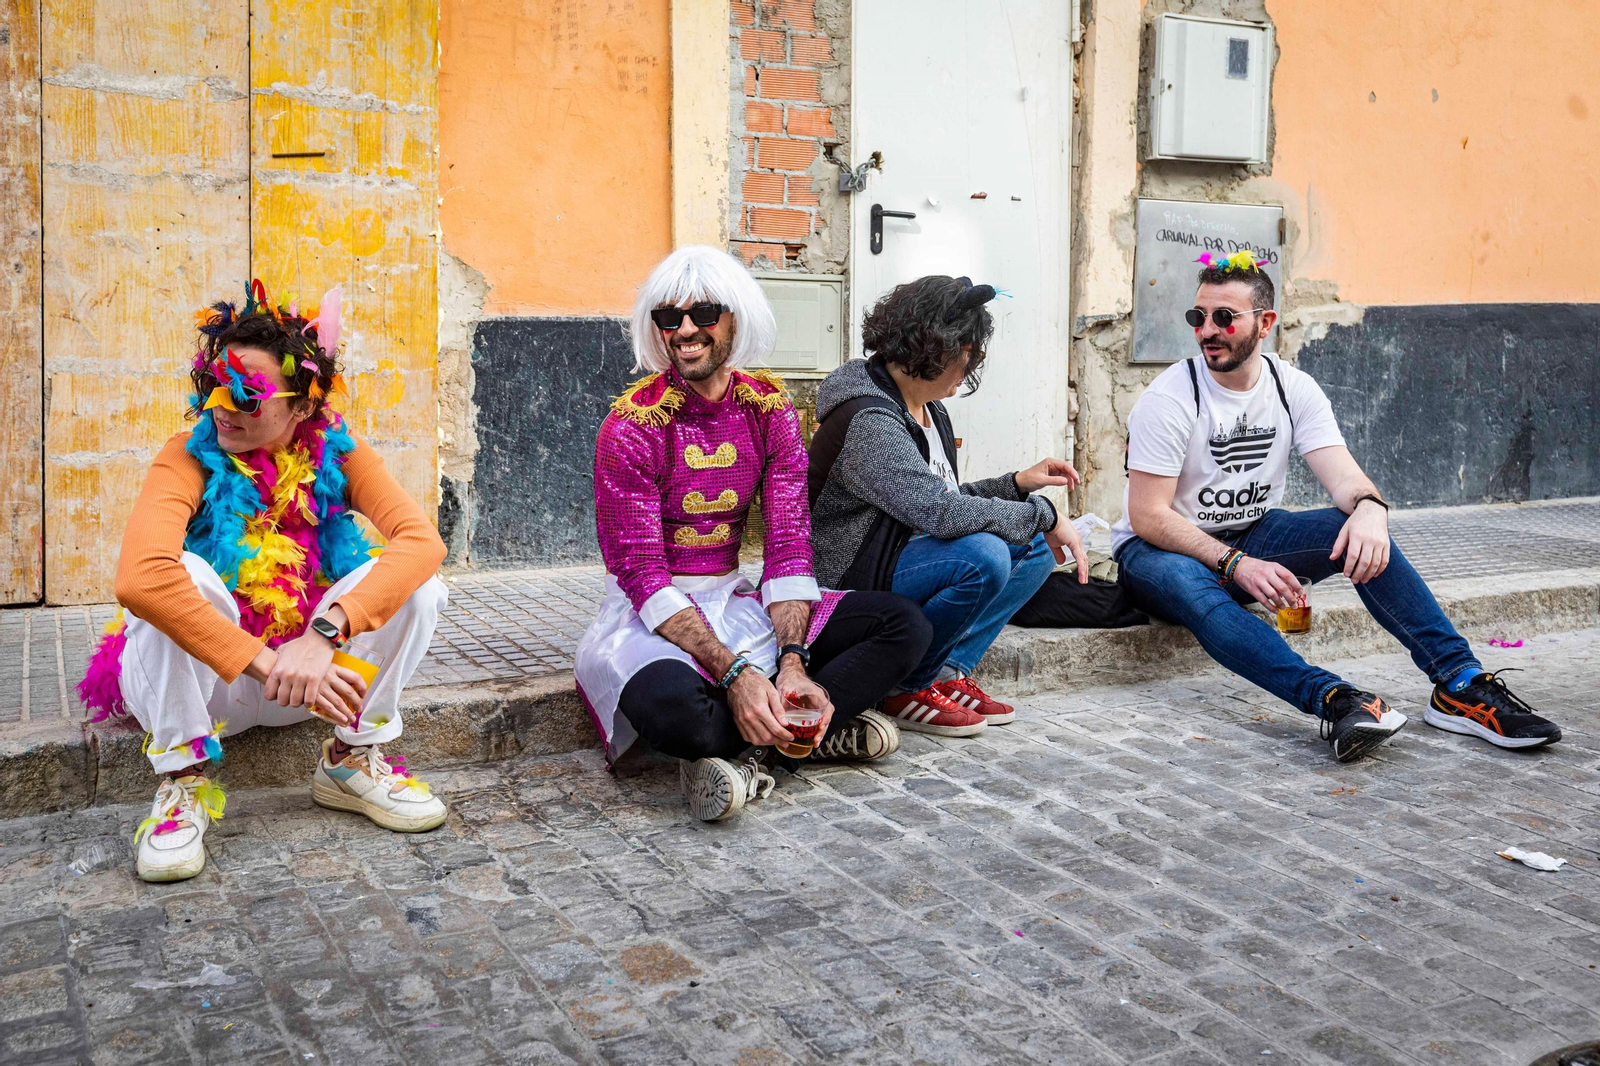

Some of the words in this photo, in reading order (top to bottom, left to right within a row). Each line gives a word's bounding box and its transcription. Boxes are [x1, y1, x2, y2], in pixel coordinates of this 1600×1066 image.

[1203, 236, 1225, 253] POR
[1197, 510, 1245, 523] original
[1247, 506, 1267, 518] city
